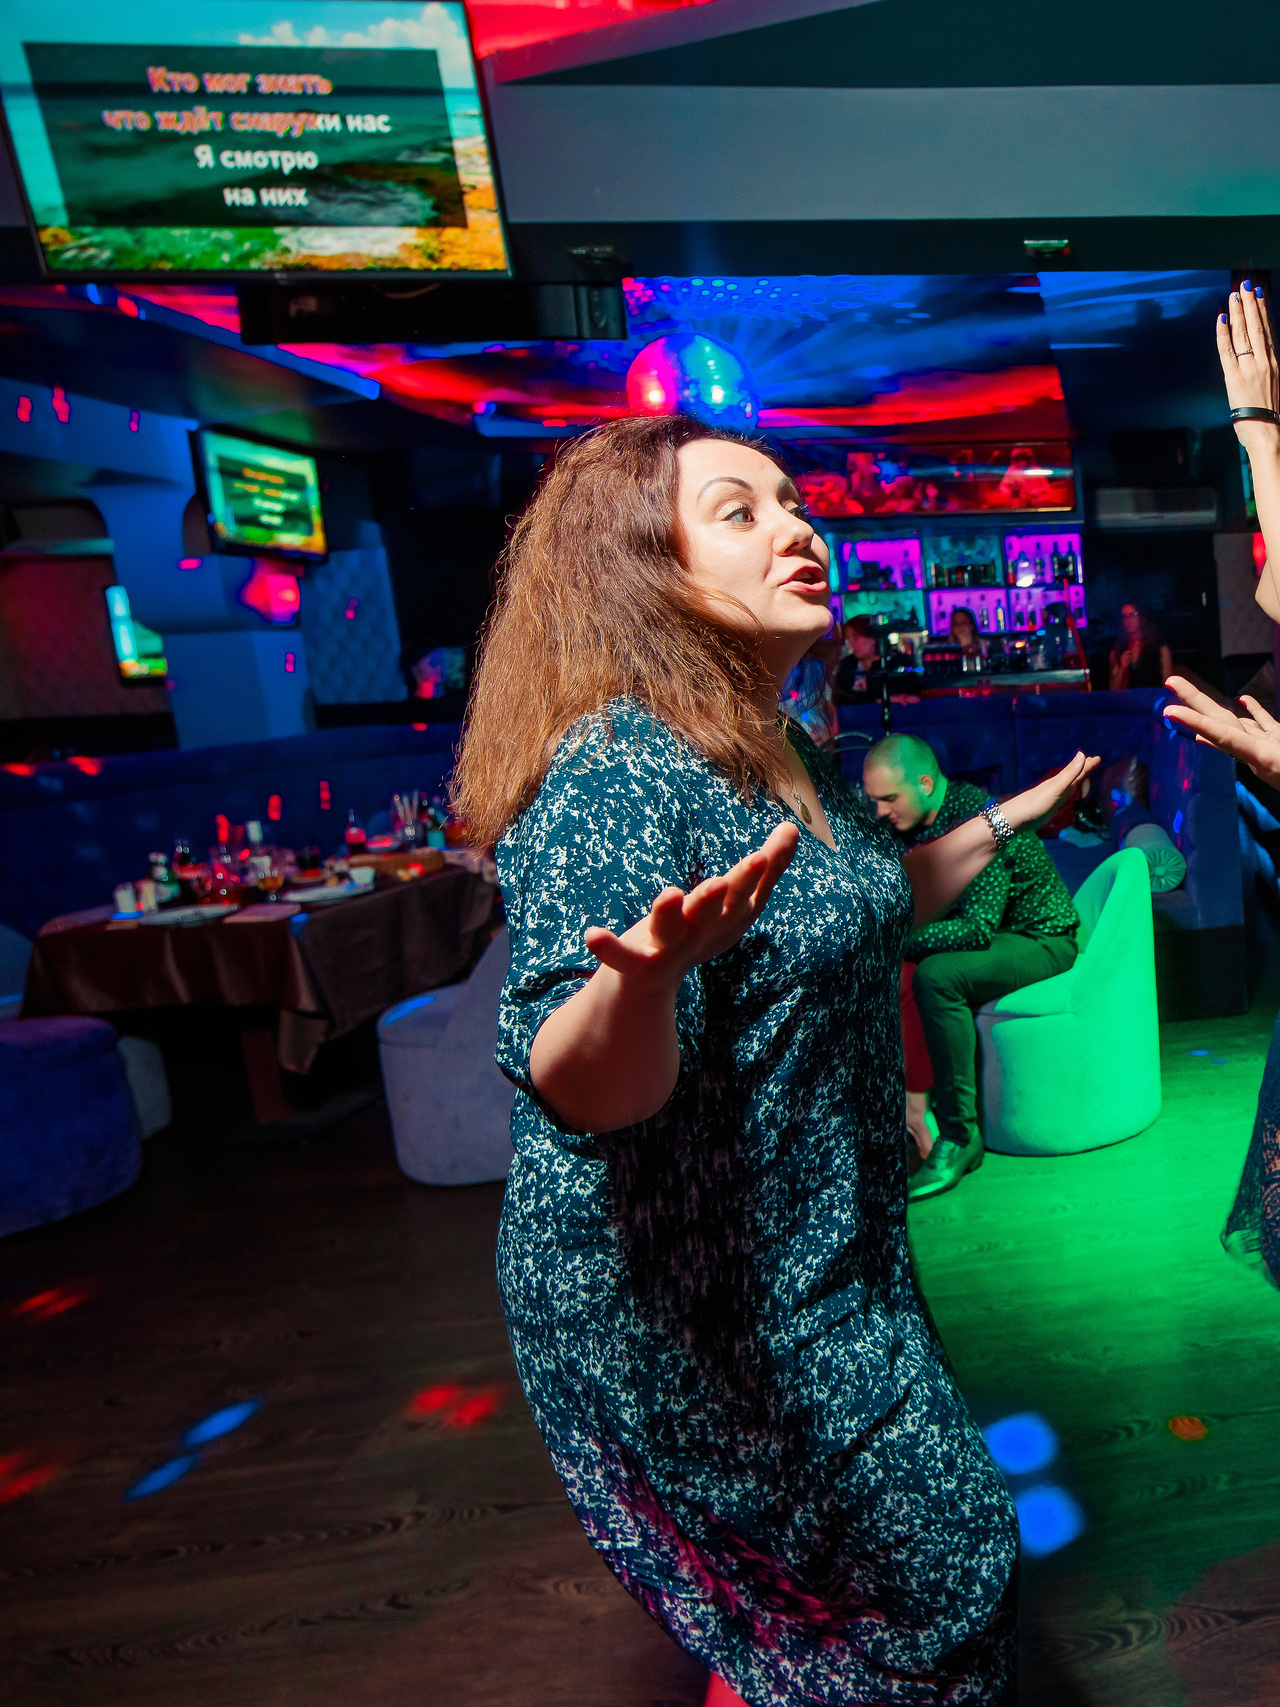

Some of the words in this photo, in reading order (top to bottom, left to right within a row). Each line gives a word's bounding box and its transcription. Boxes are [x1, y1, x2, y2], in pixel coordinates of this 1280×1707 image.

[146, 66, 199, 93] Кто
[203, 72, 251, 95] мог
[255, 73, 333, 95] знать
[102, 110, 151, 132] что
[229, 111, 342, 138] снаружи
[346, 114, 392, 133] нас
[194, 144, 215, 168] Я
[220, 150, 319, 175] смотрю
[223, 187, 257, 207] на
[260, 187, 309, 207] них
